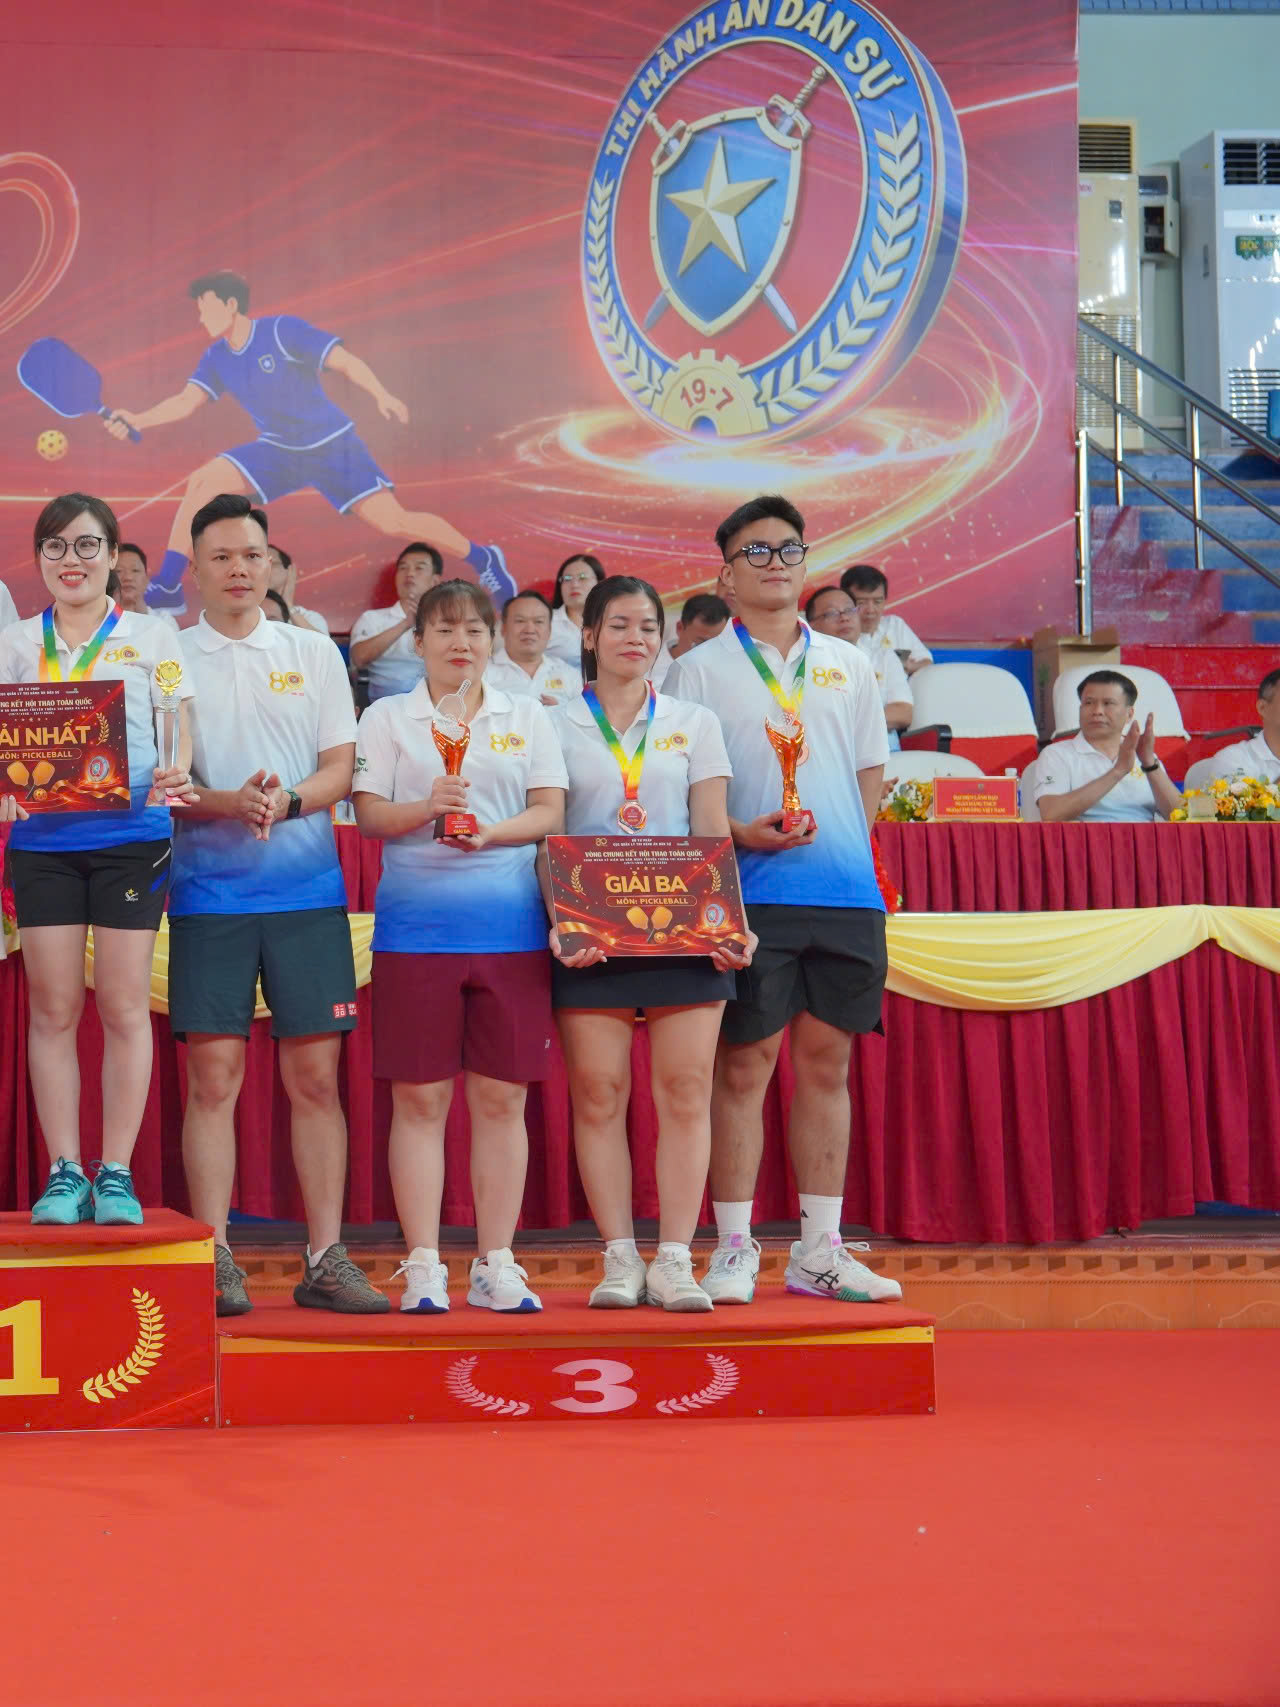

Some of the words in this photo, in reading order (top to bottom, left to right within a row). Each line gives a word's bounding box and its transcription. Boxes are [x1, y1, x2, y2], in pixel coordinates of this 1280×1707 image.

[605, 98, 642, 156] THI
[638, 12, 716, 101] HÀNH
[844, 37, 906, 99] SỰ
[10, 699, 24, 708] KẾT
[56, 698, 74, 706] TOÀN
[74, 697, 93, 706] QUỐC
[25, 718, 91, 746] NHẤT
[22, 750, 73, 759] PICKLEBALL
[584, 850, 602, 858] VÒNG
[686, 849, 703, 857] QUỐC
[605, 871, 650, 893] GIẢI
[655, 875, 688, 893] BA
[616, 897, 638, 905] MÔN:
[640, 897, 689, 905] PICKLEBALL
[549, 1359, 638, 1413] 3
